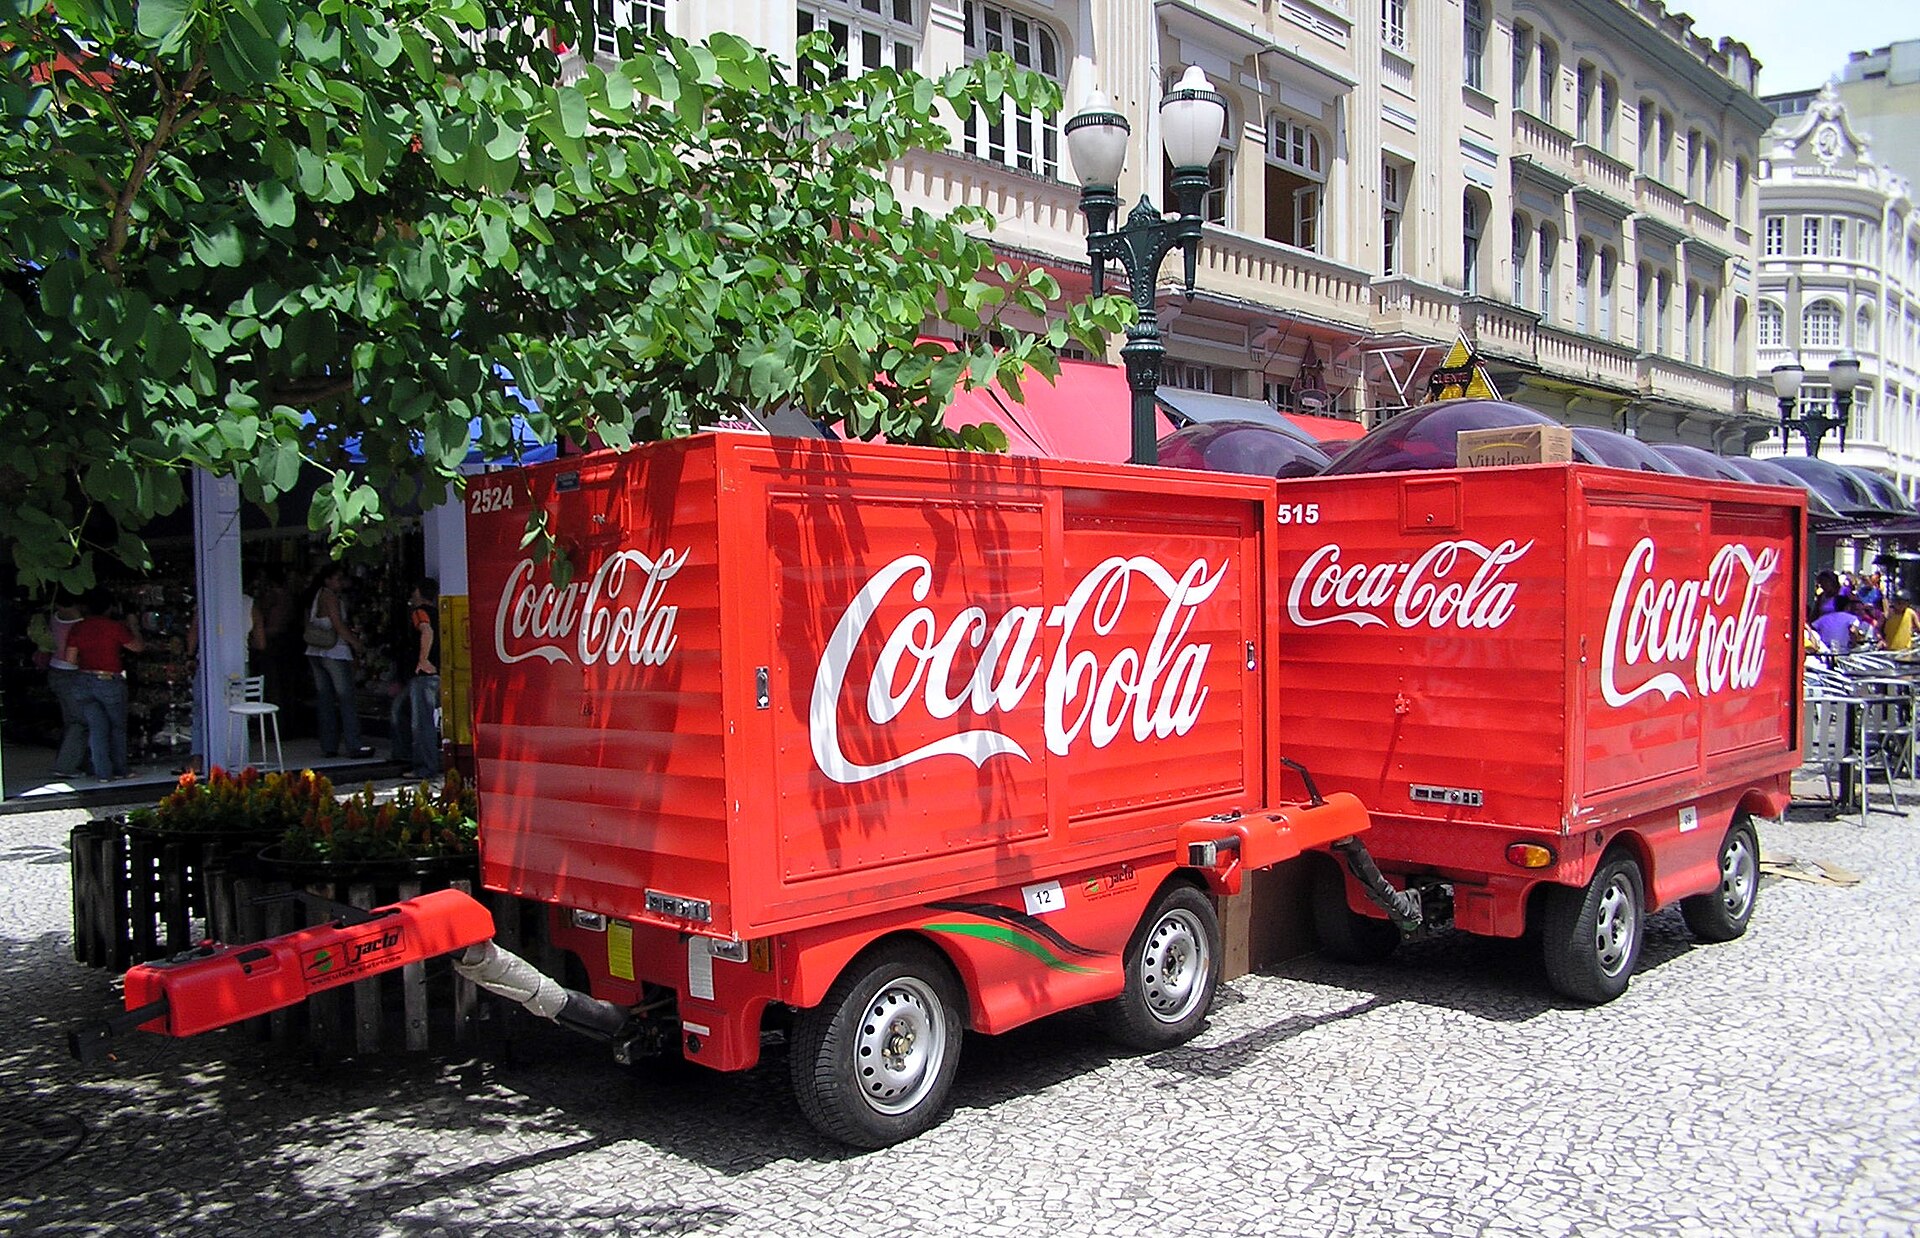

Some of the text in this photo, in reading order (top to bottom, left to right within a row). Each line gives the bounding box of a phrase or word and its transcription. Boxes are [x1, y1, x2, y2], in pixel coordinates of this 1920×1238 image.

[471, 485, 514, 514] 2524
[1277, 504, 1319, 524] 515
[494, 546, 692, 666] Coca-Cola
[1287, 538, 1535, 629] Coca-Cola
[1601, 536, 1780, 708] Coca-Cola
[809, 554, 1230, 784] Coca-Cola
[1035, 890, 1052, 905] 12
